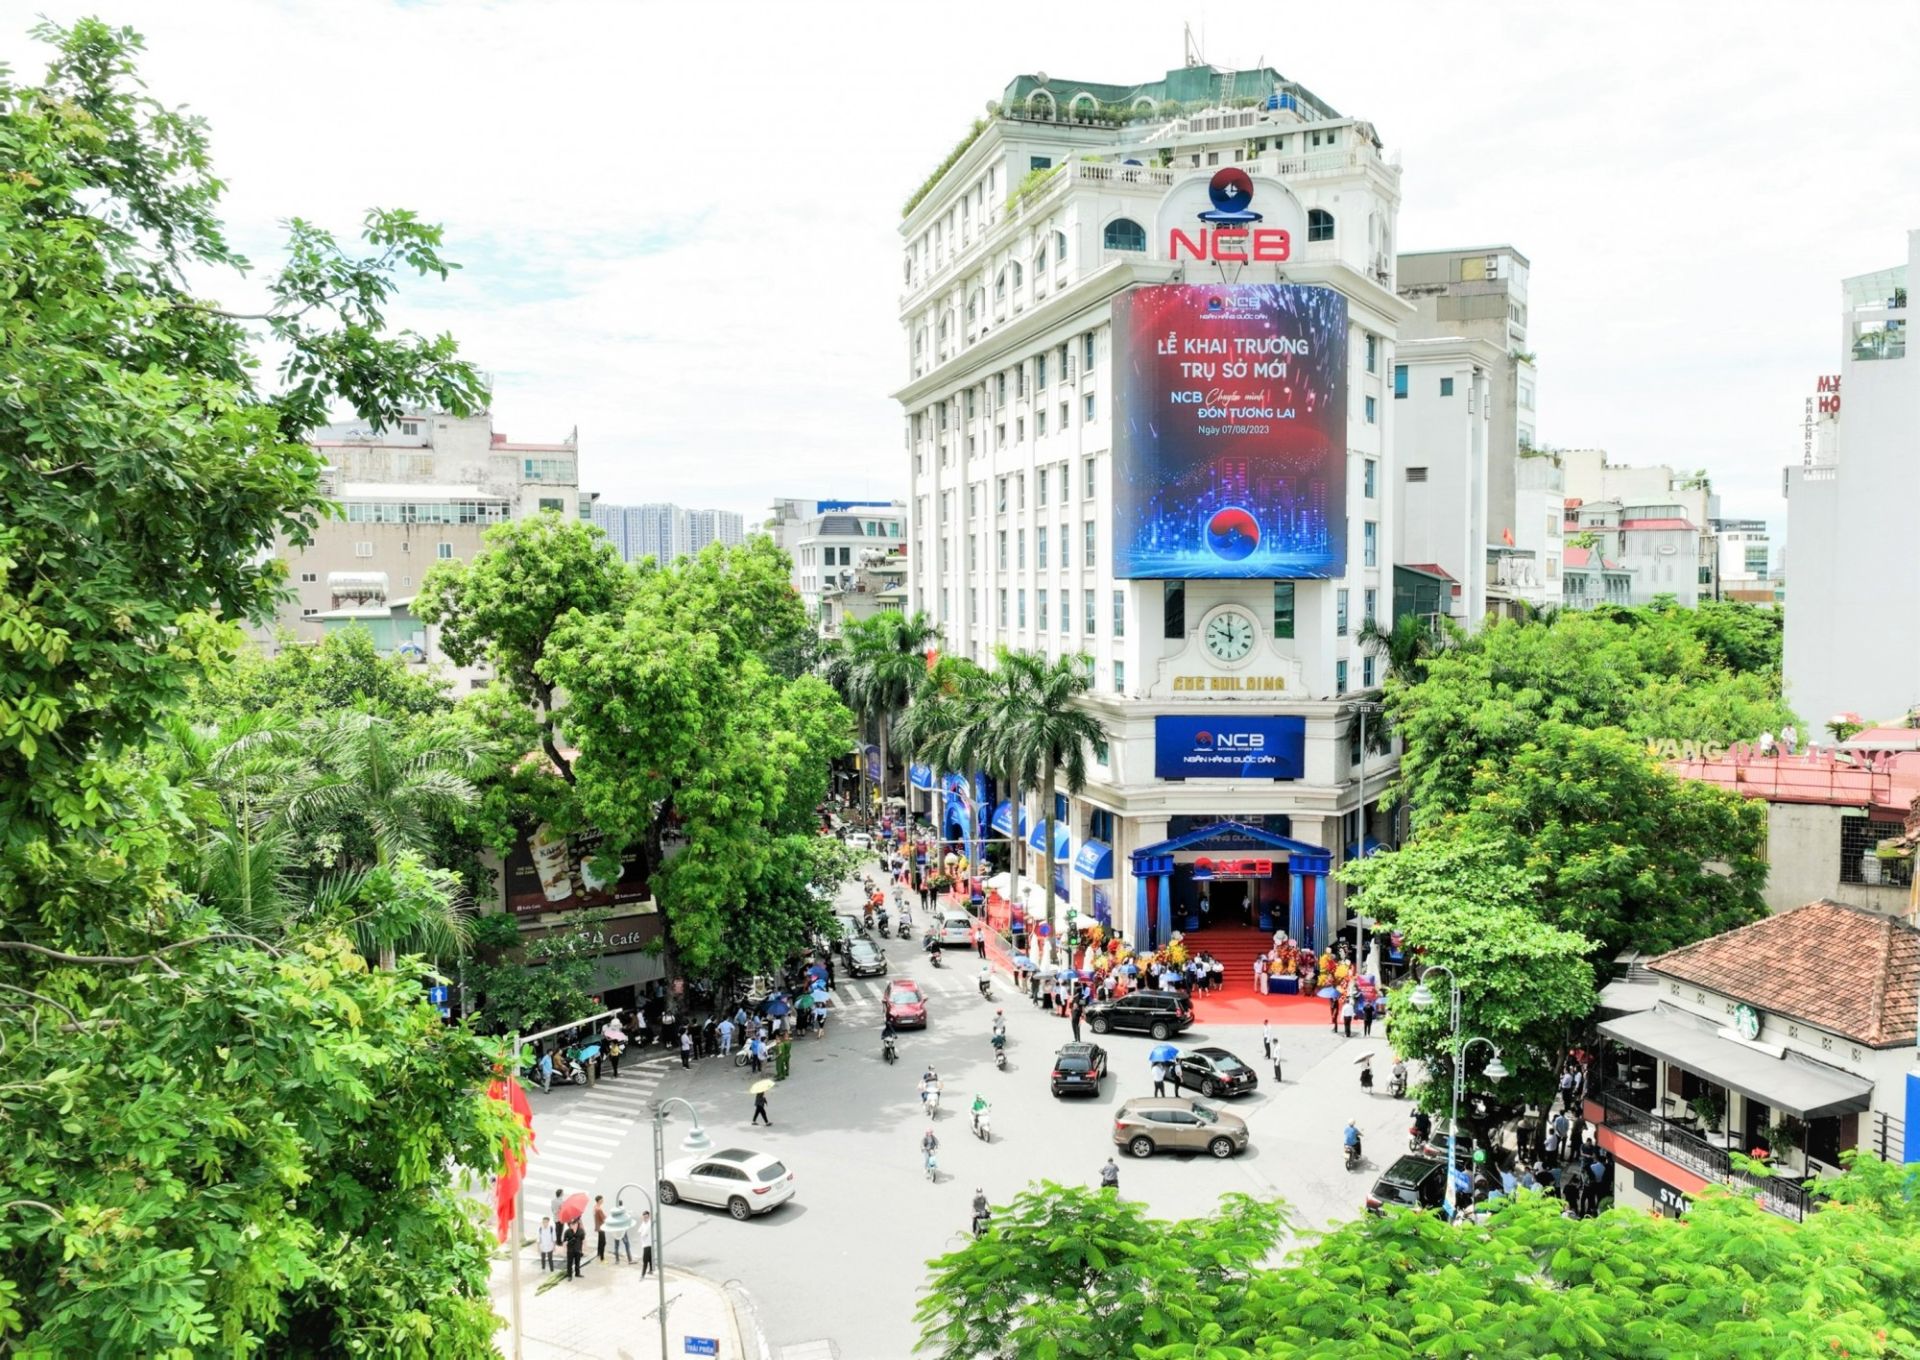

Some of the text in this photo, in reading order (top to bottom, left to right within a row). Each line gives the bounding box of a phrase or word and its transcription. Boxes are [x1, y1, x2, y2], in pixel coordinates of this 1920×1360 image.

[1170, 228, 1291, 261] NCB
[1225, 297, 1260, 307] NCB
[1158, 331, 1309, 355] LỄ KHAI TRƯƠNG
[1180, 358, 1287, 382] TRỤ SỞ MỚI
[1171, 391, 1203, 404] NCB
[1197, 406, 1296, 419] ĐÓN TƯƠNG LAI
[1198, 424, 1270, 436] Ngày 07/08/2023
[1217, 733, 1265, 747] NCB
[1183, 755, 1276, 763] NGÂN HÀNG QUỐC DÂN
[1219, 857, 1272, 875] NCB
[609, 932, 640, 946] Café
